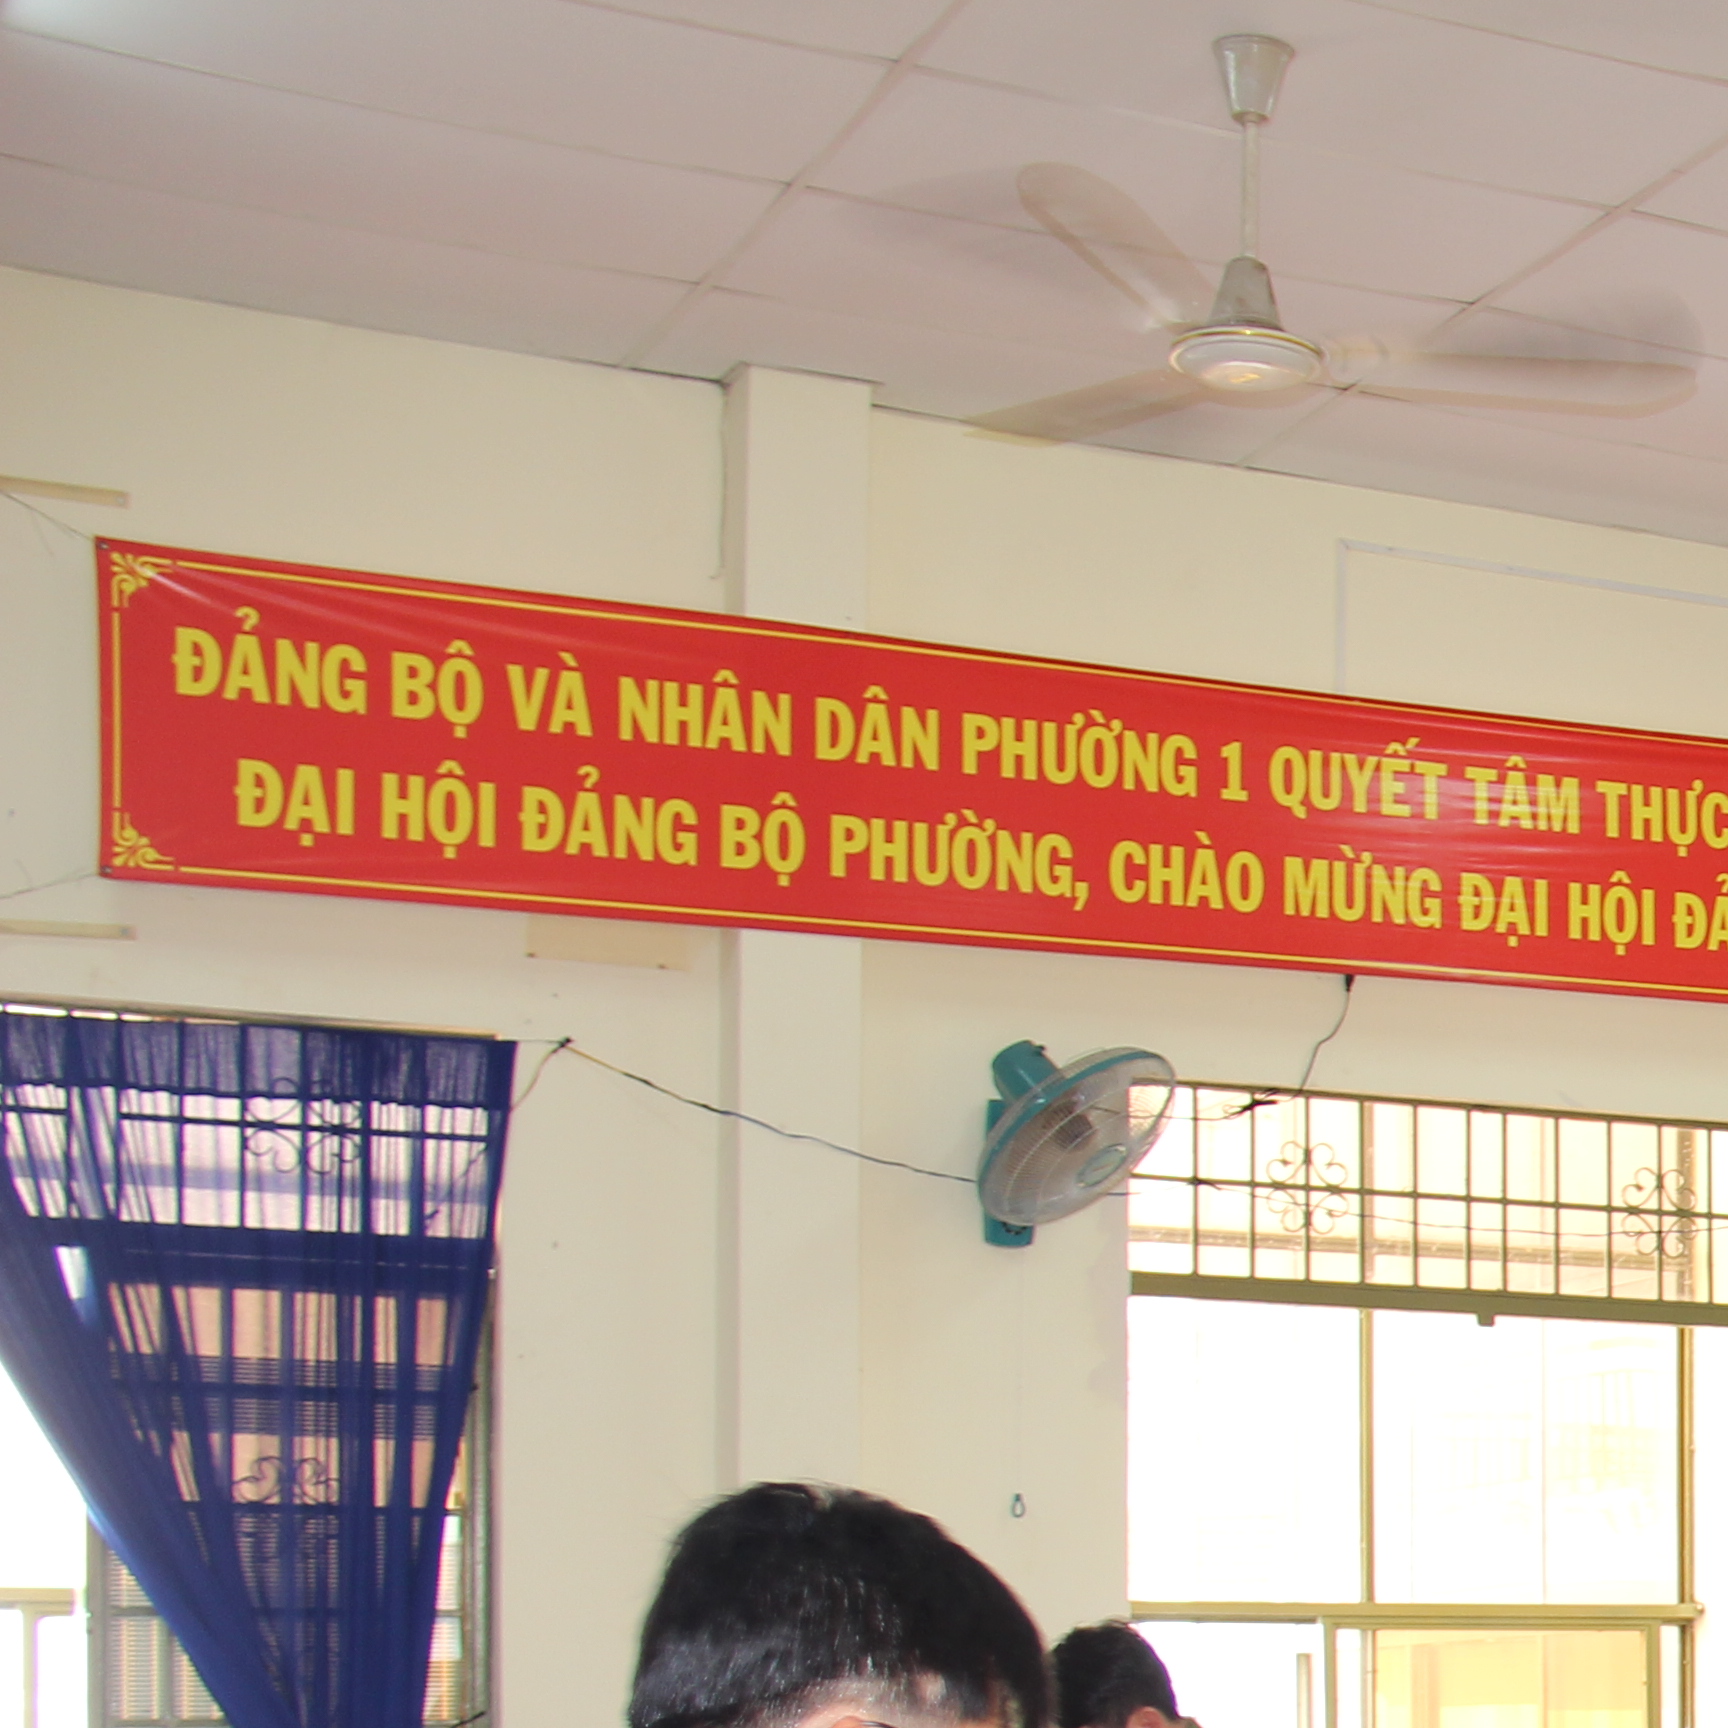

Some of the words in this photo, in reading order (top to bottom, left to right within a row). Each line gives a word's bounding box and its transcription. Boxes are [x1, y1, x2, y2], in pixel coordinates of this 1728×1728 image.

[172, 607, 367, 714] ĐẢNG
[392, 640, 483, 740] BỘ
[507, 652, 592, 736] VÀ
[619, 669, 791, 756] NHÂN
[816, 686, 939, 771] DÂN
[962, 710, 1197, 797] PHƯỜNG
[1221, 742, 1248, 801] 1
[1269, 737, 1448, 821] QUYẾT
[1464, 755, 1581, 834] TÂM
[234, 759, 354, 846] ĐẠI
[381, 760, 496, 860] HỘI
[519, 765, 698, 866] ĐẢNG
[721, 792, 805, 886] BỘ
[830, 809, 1089, 911] PHƯỜNG,
[1109, 831, 1264, 912] CHÀO
[1284, 845, 1442, 929] MỪNG
[1457, 870, 1548, 947] ĐẠI
[1568, 871, 1655, 957] HỘI
